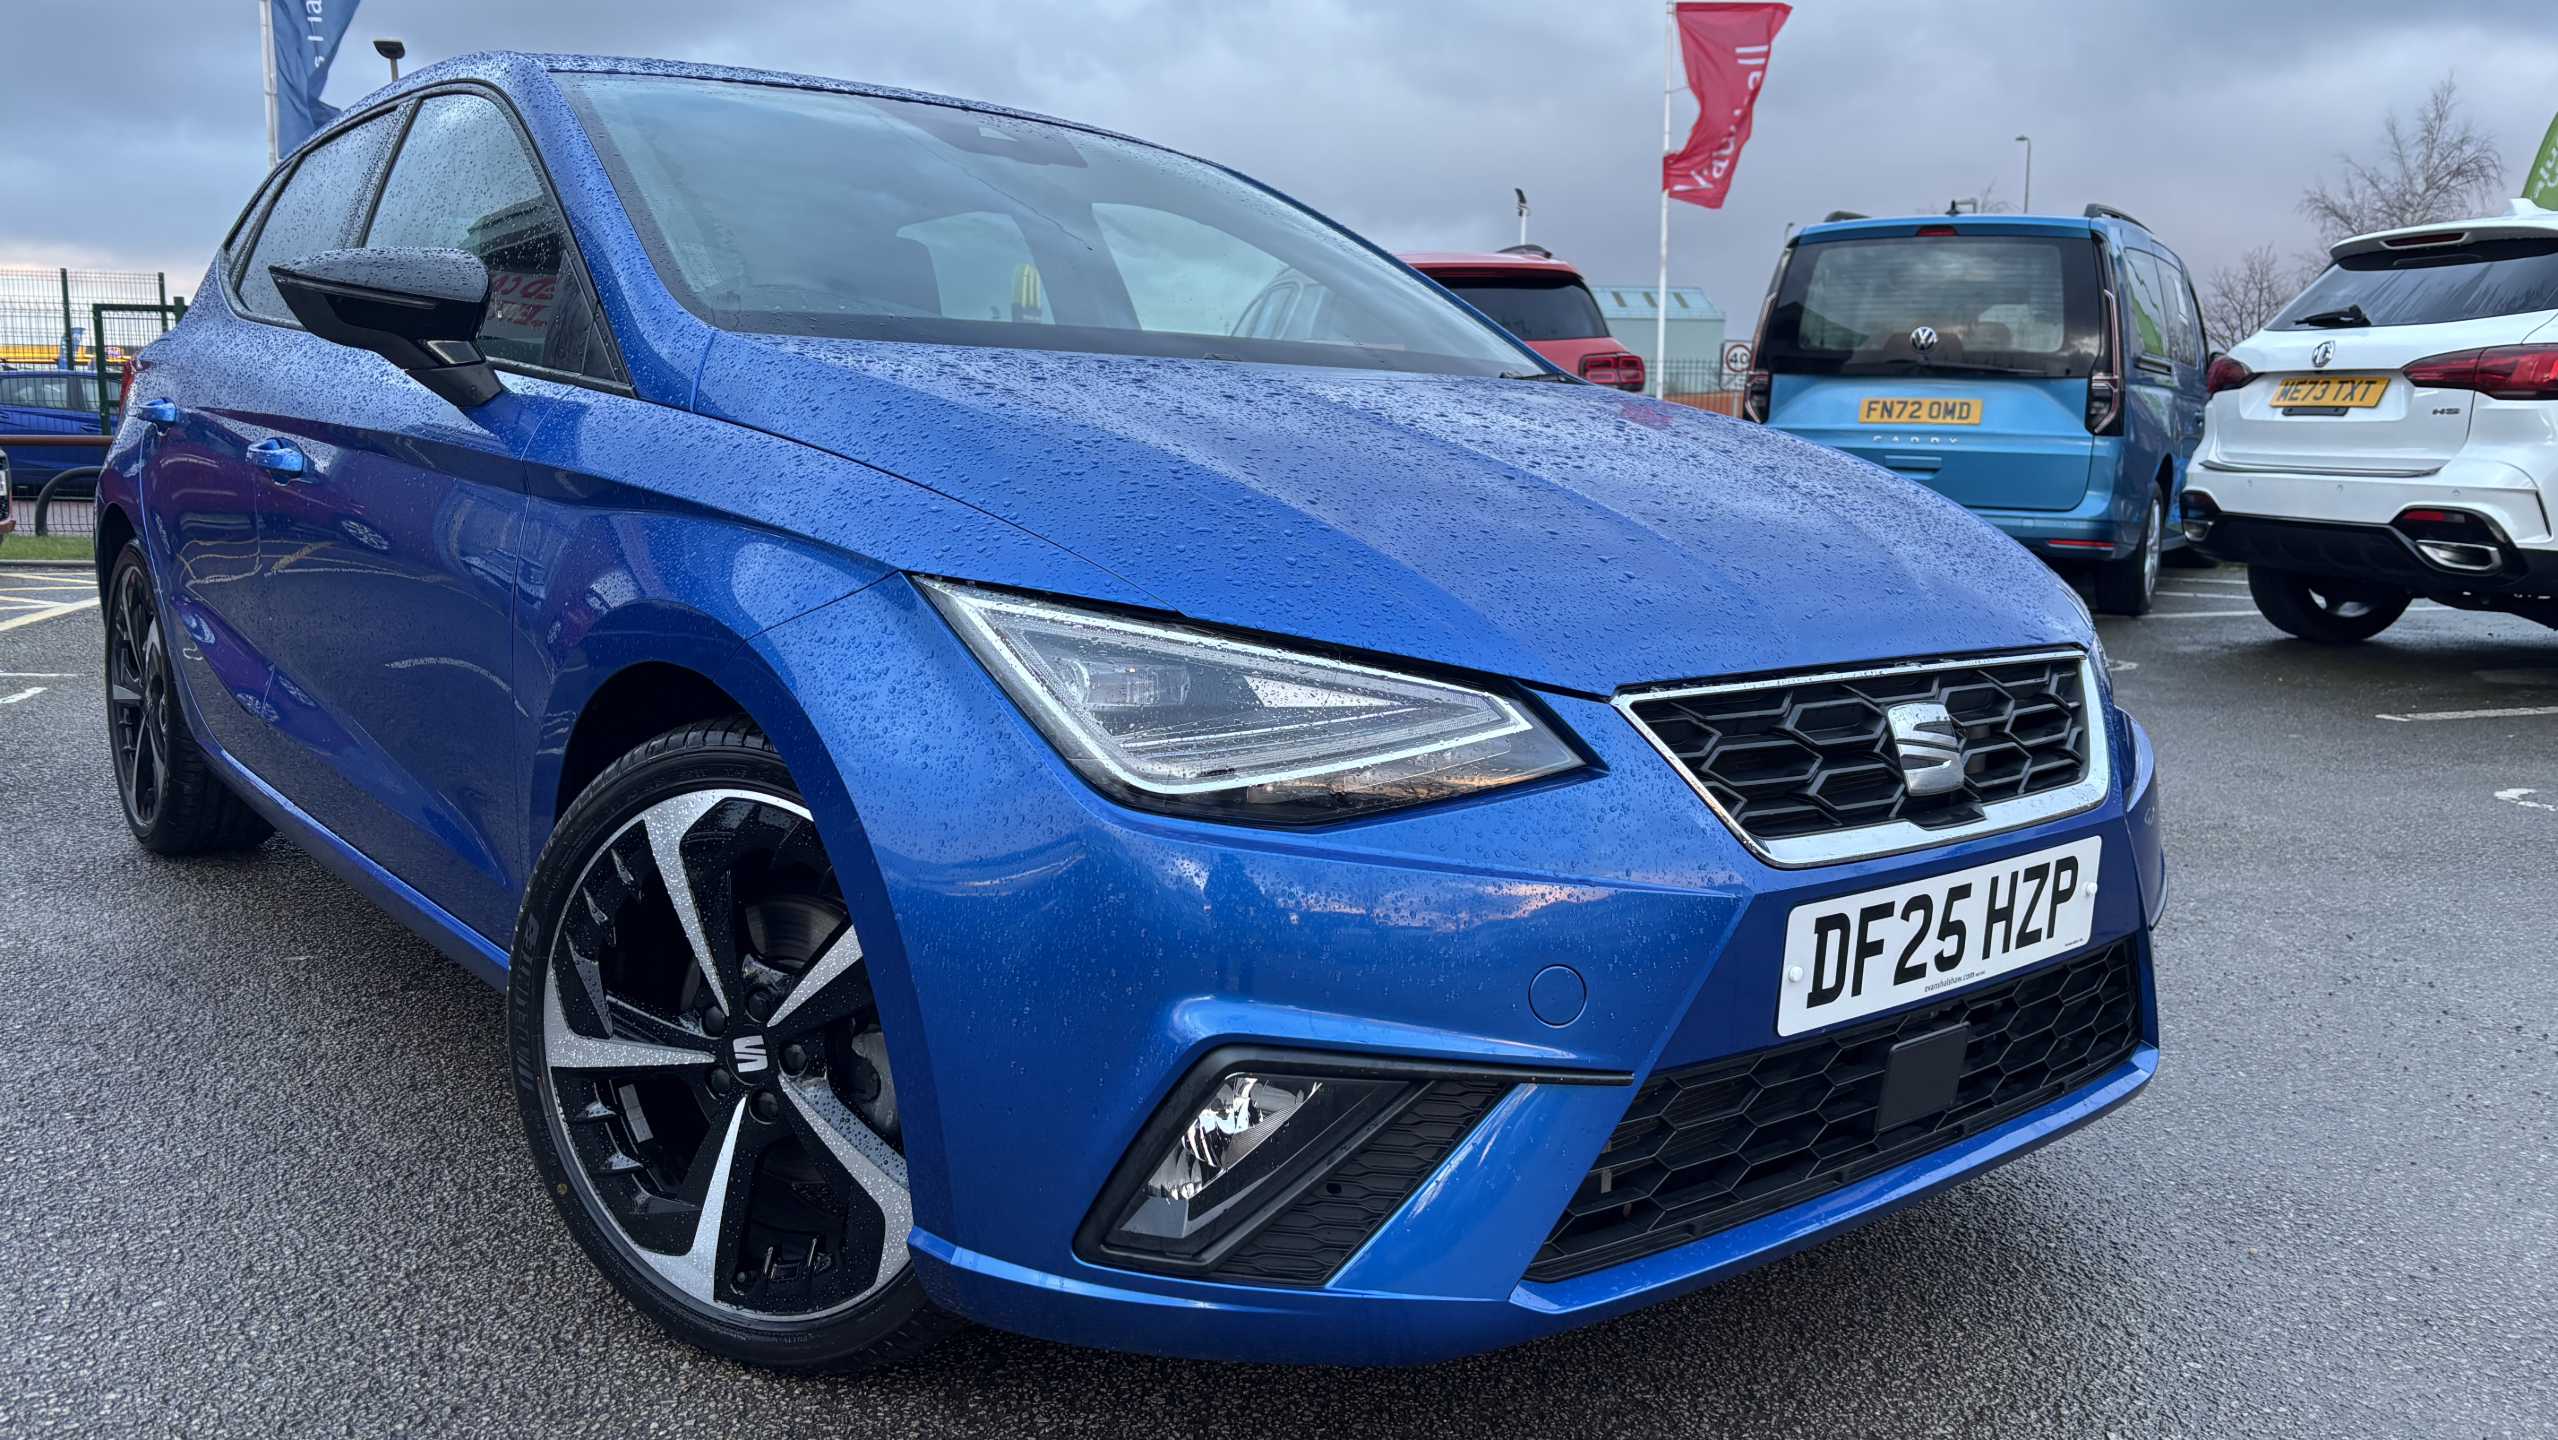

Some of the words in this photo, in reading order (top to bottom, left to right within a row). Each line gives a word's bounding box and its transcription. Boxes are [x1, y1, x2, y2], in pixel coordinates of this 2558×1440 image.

[2333, 379, 2378, 402] TXT
[1866, 401, 1923, 419] FN72
[1927, 401, 1972, 420] OMD
[1806, 882, 1973, 1009] DF25
[1982, 855, 2079, 961] HZP
